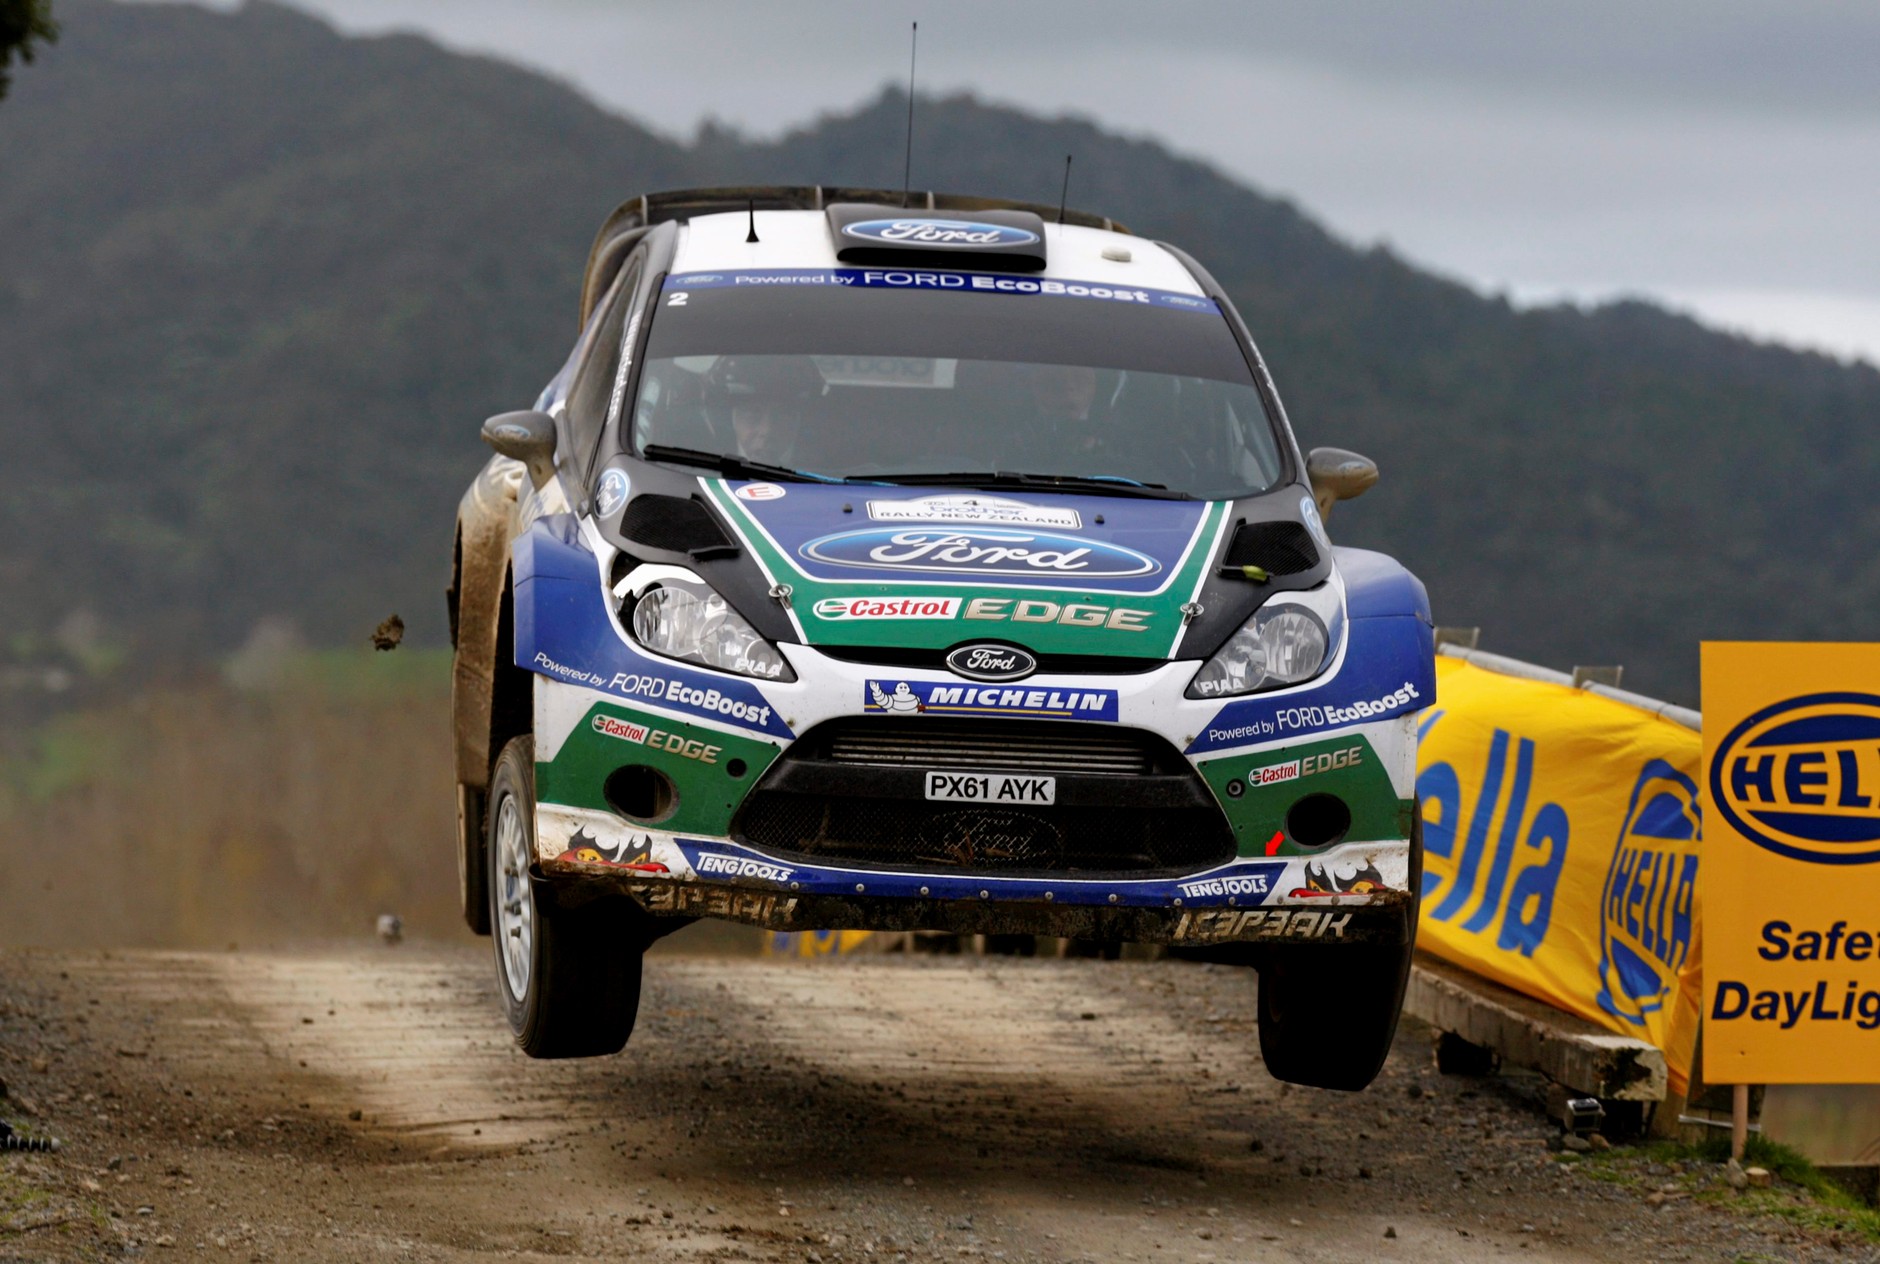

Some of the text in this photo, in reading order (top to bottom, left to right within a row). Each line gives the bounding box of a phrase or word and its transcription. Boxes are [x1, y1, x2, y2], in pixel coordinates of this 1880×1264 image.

[880, 222, 1000, 244] Ford
[667, 292, 689, 306] 2
[735, 271, 1150, 303] Powered by FORD EcoBoost
[941, 512, 981, 520] NEW
[989, 513, 1072, 525] ZEALAND
[869, 531, 1093, 570] Ford
[848, 597, 1153, 632] Castrol EDGE
[734, 657, 781, 677] PIAA
[966, 648, 1016, 671] Ford
[534, 651, 771, 727] Powered by FORD EcoBoost
[928, 687, 1107, 711] MICHELIN
[1199, 677, 1245, 693] PIAA
[1209, 681, 1420, 742] Powered by FORD EcoBoost
[604, 718, 723, 765] Castrol EDGE
[1261, 745, 1364, 783] Castrol EDGE
[1730, 748, 1880, 809] HEL
[930, 775, 1049, 801] PX61 AYK
[1415, 710, 1570, 958] ella
[1608, 847, 1699, 976] HELLA
[1757, 919, 1880, 962] Safe
